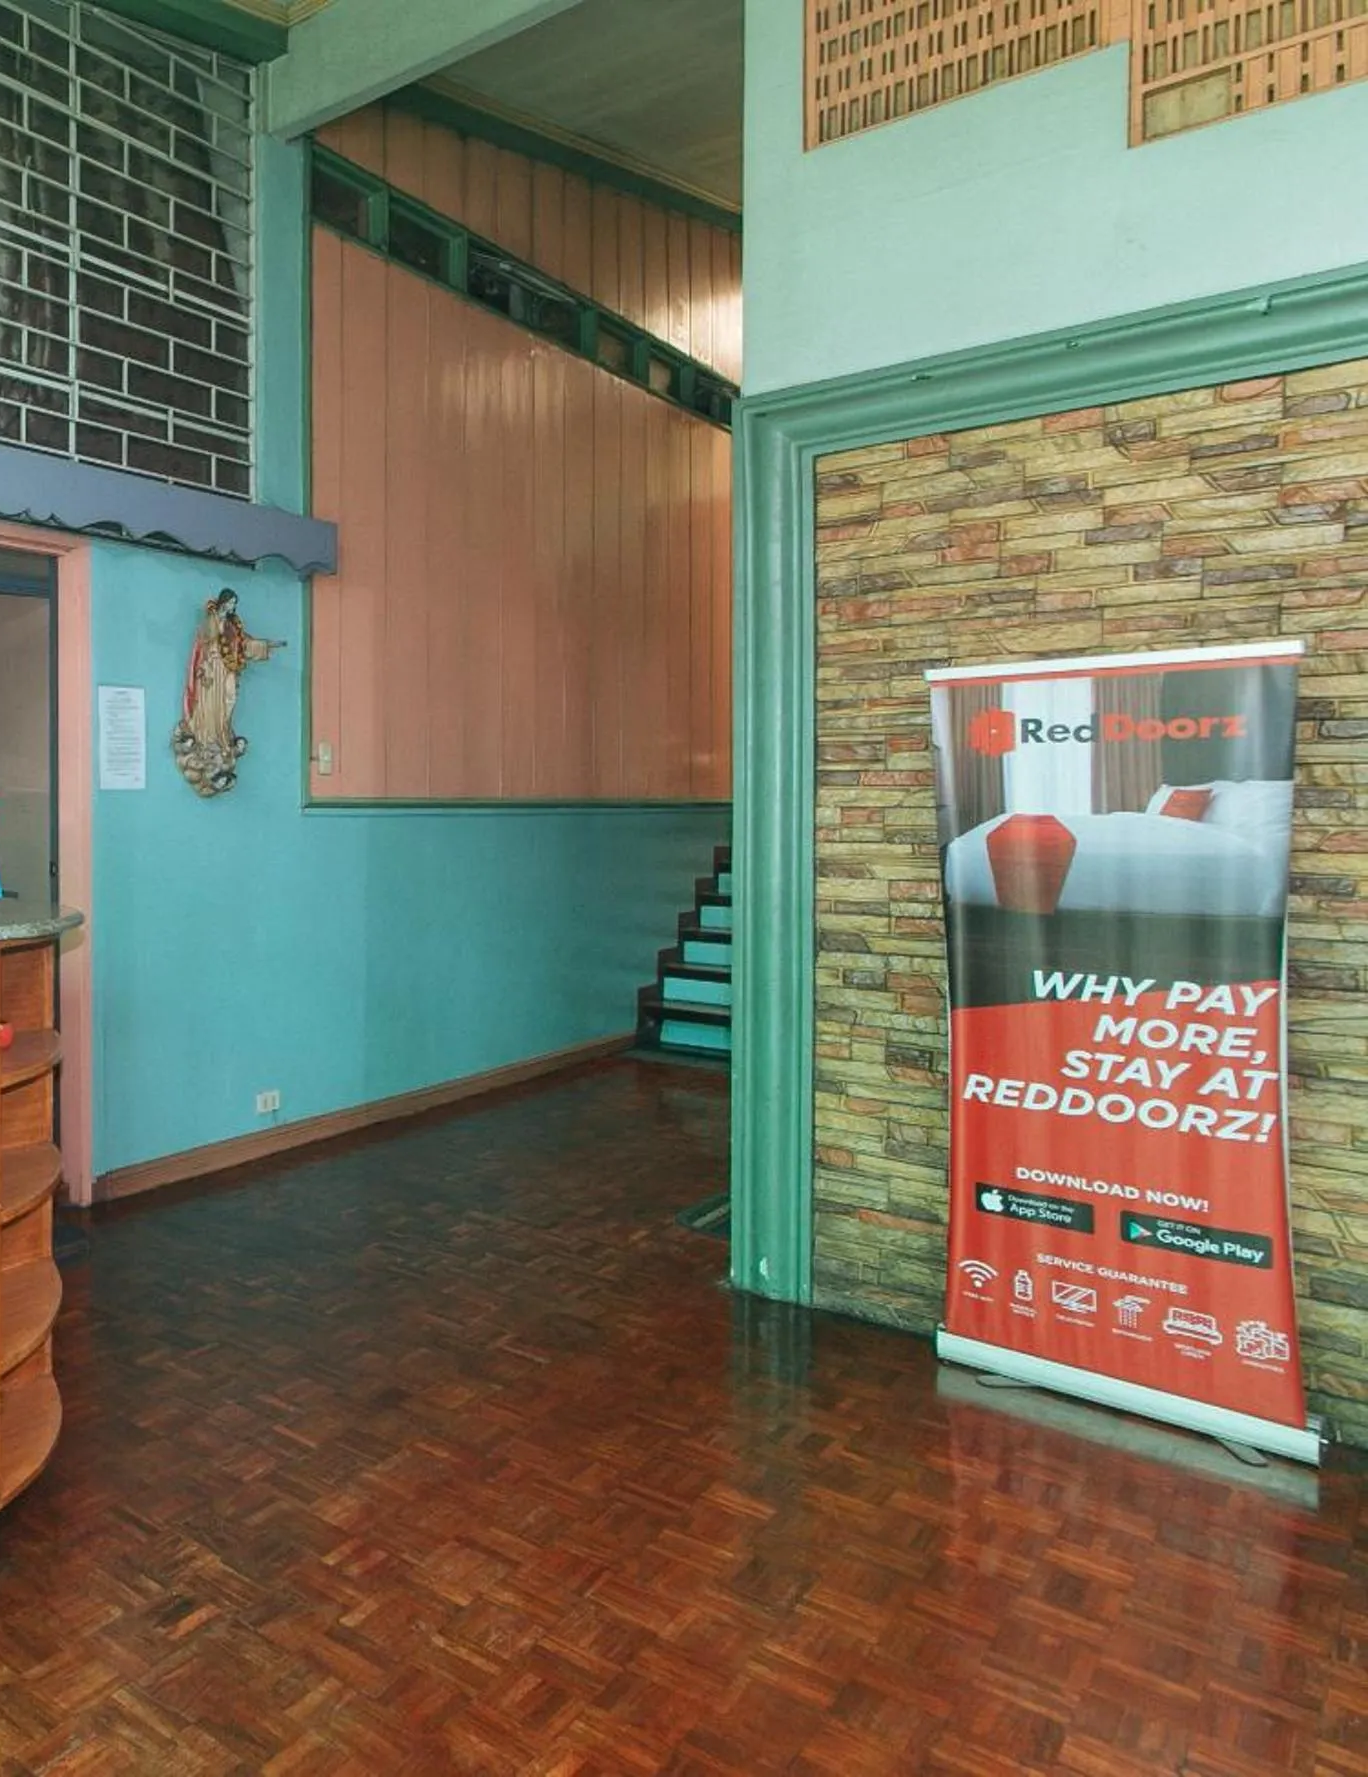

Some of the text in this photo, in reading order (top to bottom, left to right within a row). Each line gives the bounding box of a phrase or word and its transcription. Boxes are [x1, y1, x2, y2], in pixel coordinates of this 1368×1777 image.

[1020, 713, 1246, 743] RedDoorz
[1033, 970, 1279, 1017] WHY PAY
[1093, 1014, 1267, 1064] MORE,
[1061, 1050, 1279, 1101] STAY AT
[963, 1073, 1277, 1143] REDDOORZ!
[1016, 1167, 1209, 1213] DOWNLOAD NOW!
[1010, 1203, 1072, 1224] App Store
[1155, 1229, 1264, 1263] Google Play
[1036, 1252, 1189, 1295] SERVICE GUARANTEE
